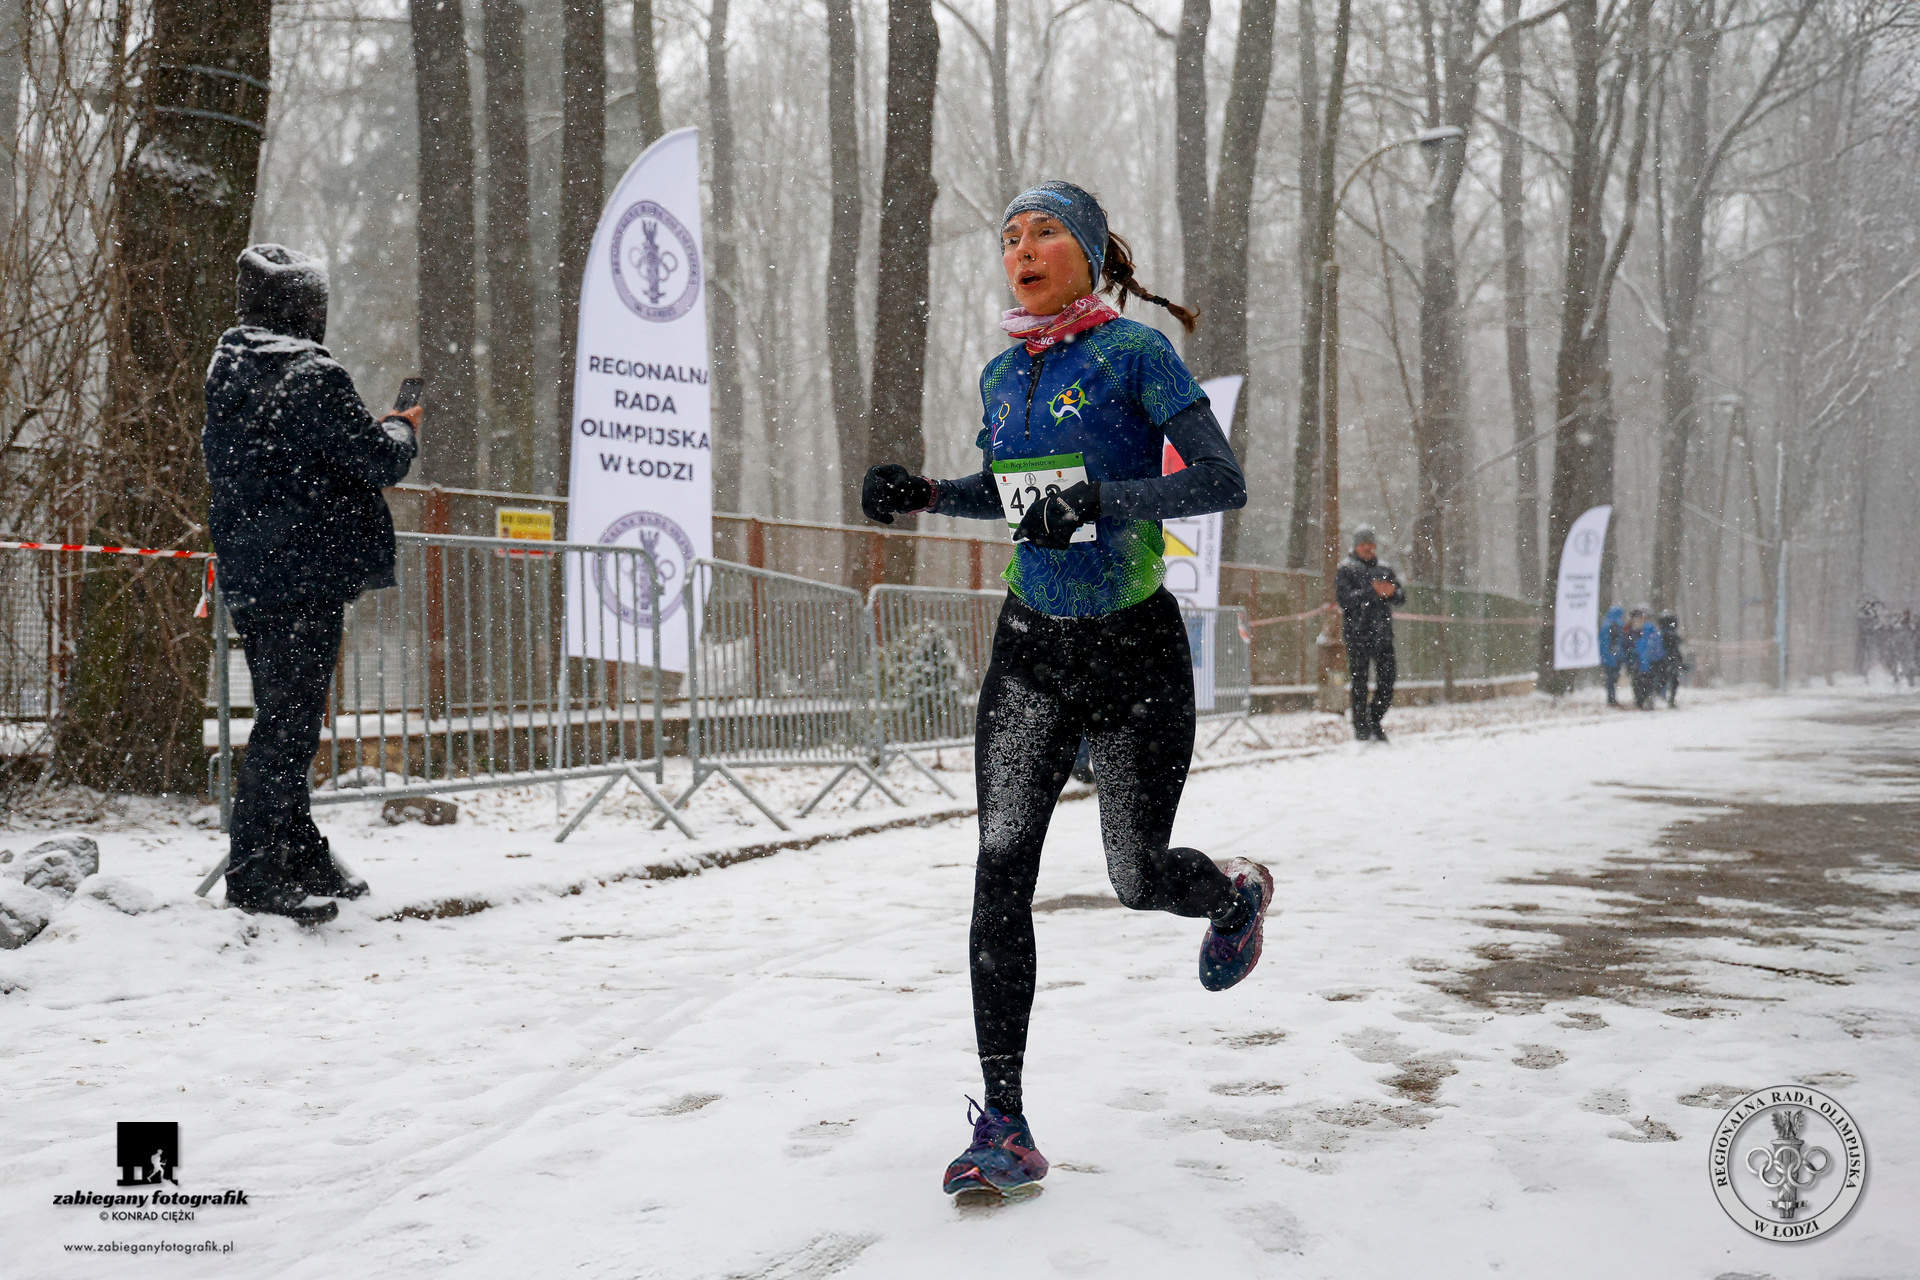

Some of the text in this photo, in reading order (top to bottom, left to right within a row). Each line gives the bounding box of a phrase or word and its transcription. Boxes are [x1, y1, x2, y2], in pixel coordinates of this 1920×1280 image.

[614, 390, 677, 414] RADA
[581, 418, 711, 449] OLIMPIJSKA
[600, 453, 693, 481] W ŁODZI
